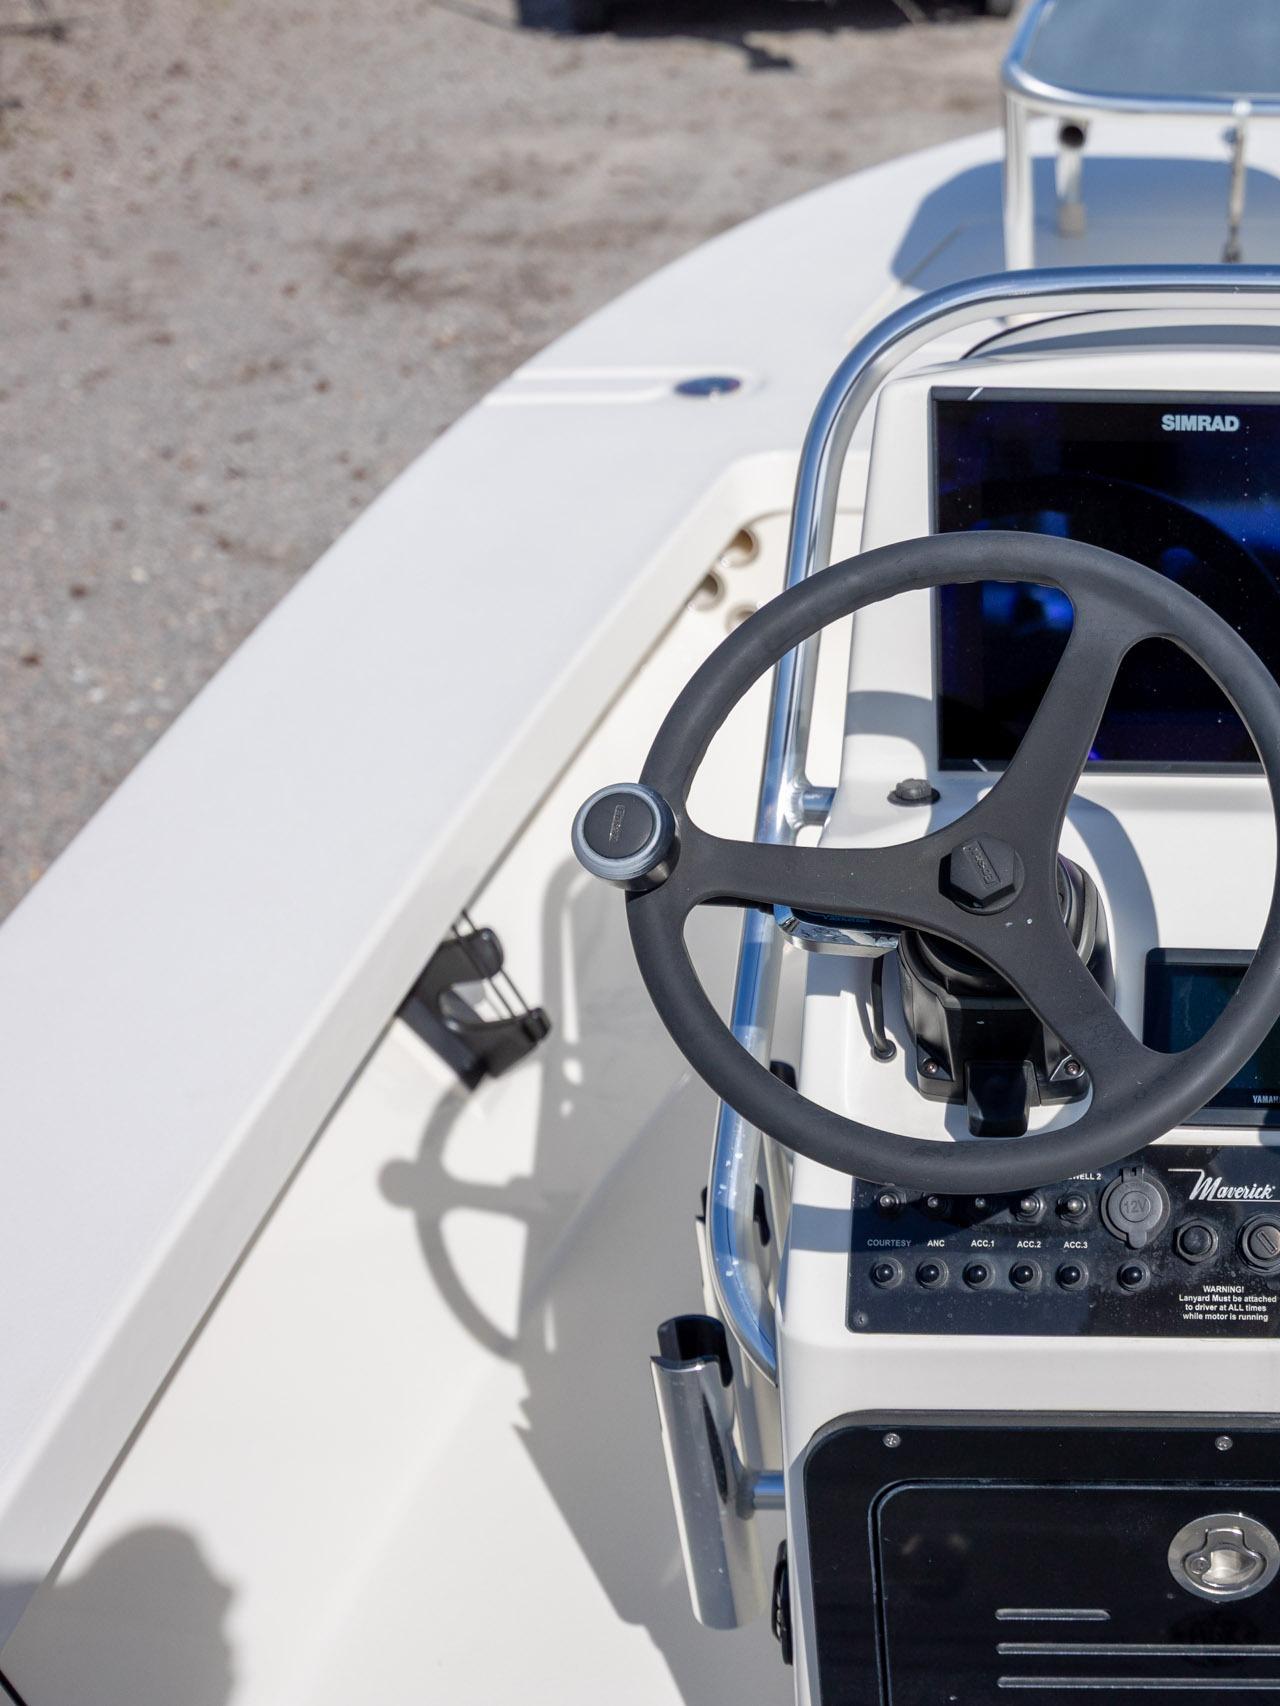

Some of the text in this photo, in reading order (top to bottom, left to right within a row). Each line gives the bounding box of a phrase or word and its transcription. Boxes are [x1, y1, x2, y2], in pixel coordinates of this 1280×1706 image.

[1161, 414, 1240, 432] SIMRAD
[1096, 1172, 1102, 1181] 2
[1168, 1168, 1276, 1201] Maverick
[1124, 1198, 1147, 1214] 12V
[867, 1239, 912, 1247] COURTESY
[927, 1239, 945, 1247] ANC
[970, 1239, 995, 1247] ACC.1
[1016, 1240, 1041, 1248] ACC.2
[1063, 1241, 1088, 1249] ACC.3
[1202, 1285, 1245, 1293] WARNING!
[1178, 1294, 1210, 1303] Lanyard
[1211, 1294, 1231, 1302] Must
[1244, 1295, 1277, 1303] attached
[1194, 1303, 1218, 1311] driver
[1245, 1304, 1267, 1312] times
[1183, 1312, 1203, 1320] while
[1238, 1313, 1269, 1322] running
